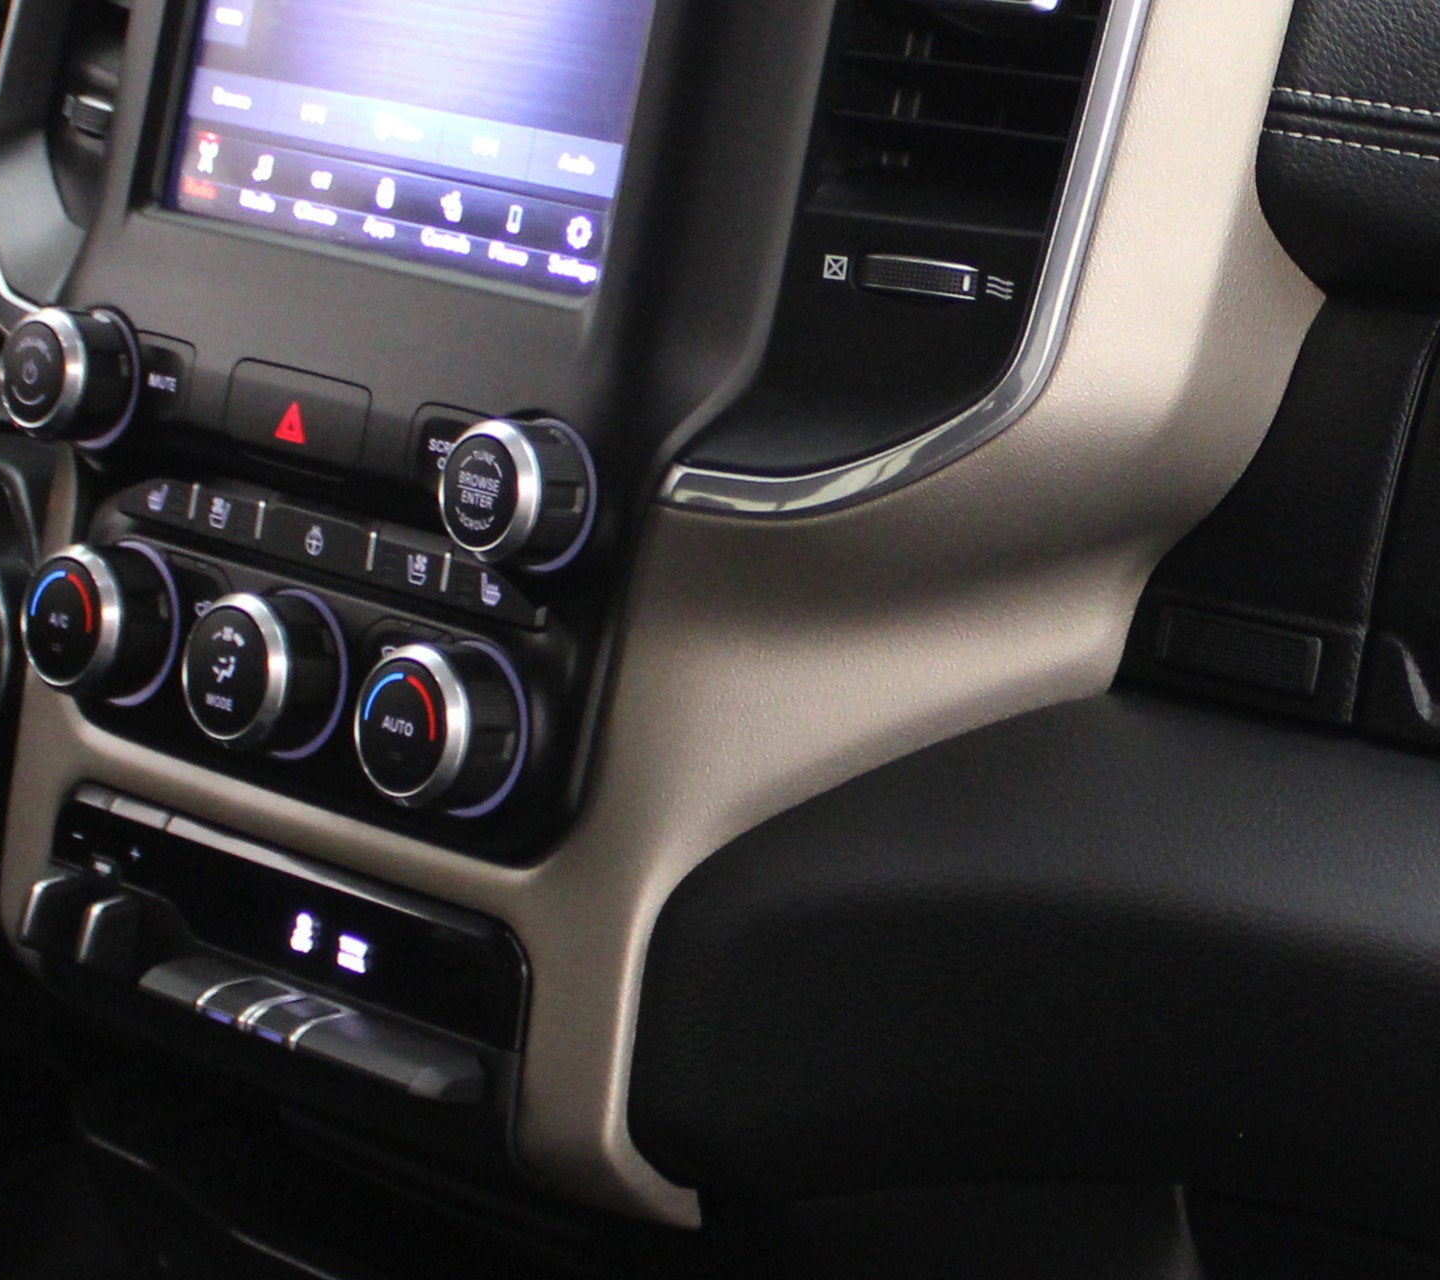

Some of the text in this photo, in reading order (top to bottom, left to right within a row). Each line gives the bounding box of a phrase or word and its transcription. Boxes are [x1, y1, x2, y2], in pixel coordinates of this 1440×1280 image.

[147, 372, 177, 393] MUTE
[428, 438, 455, 454] SCR
[458, 471, 500, 492] BROWSE
[460, 491, 494, 510] ENTER
[49, 613, 69, 631] A/C
[205, 693, 234, 714] MODE
[381, 714, 414, 738] AUTO
